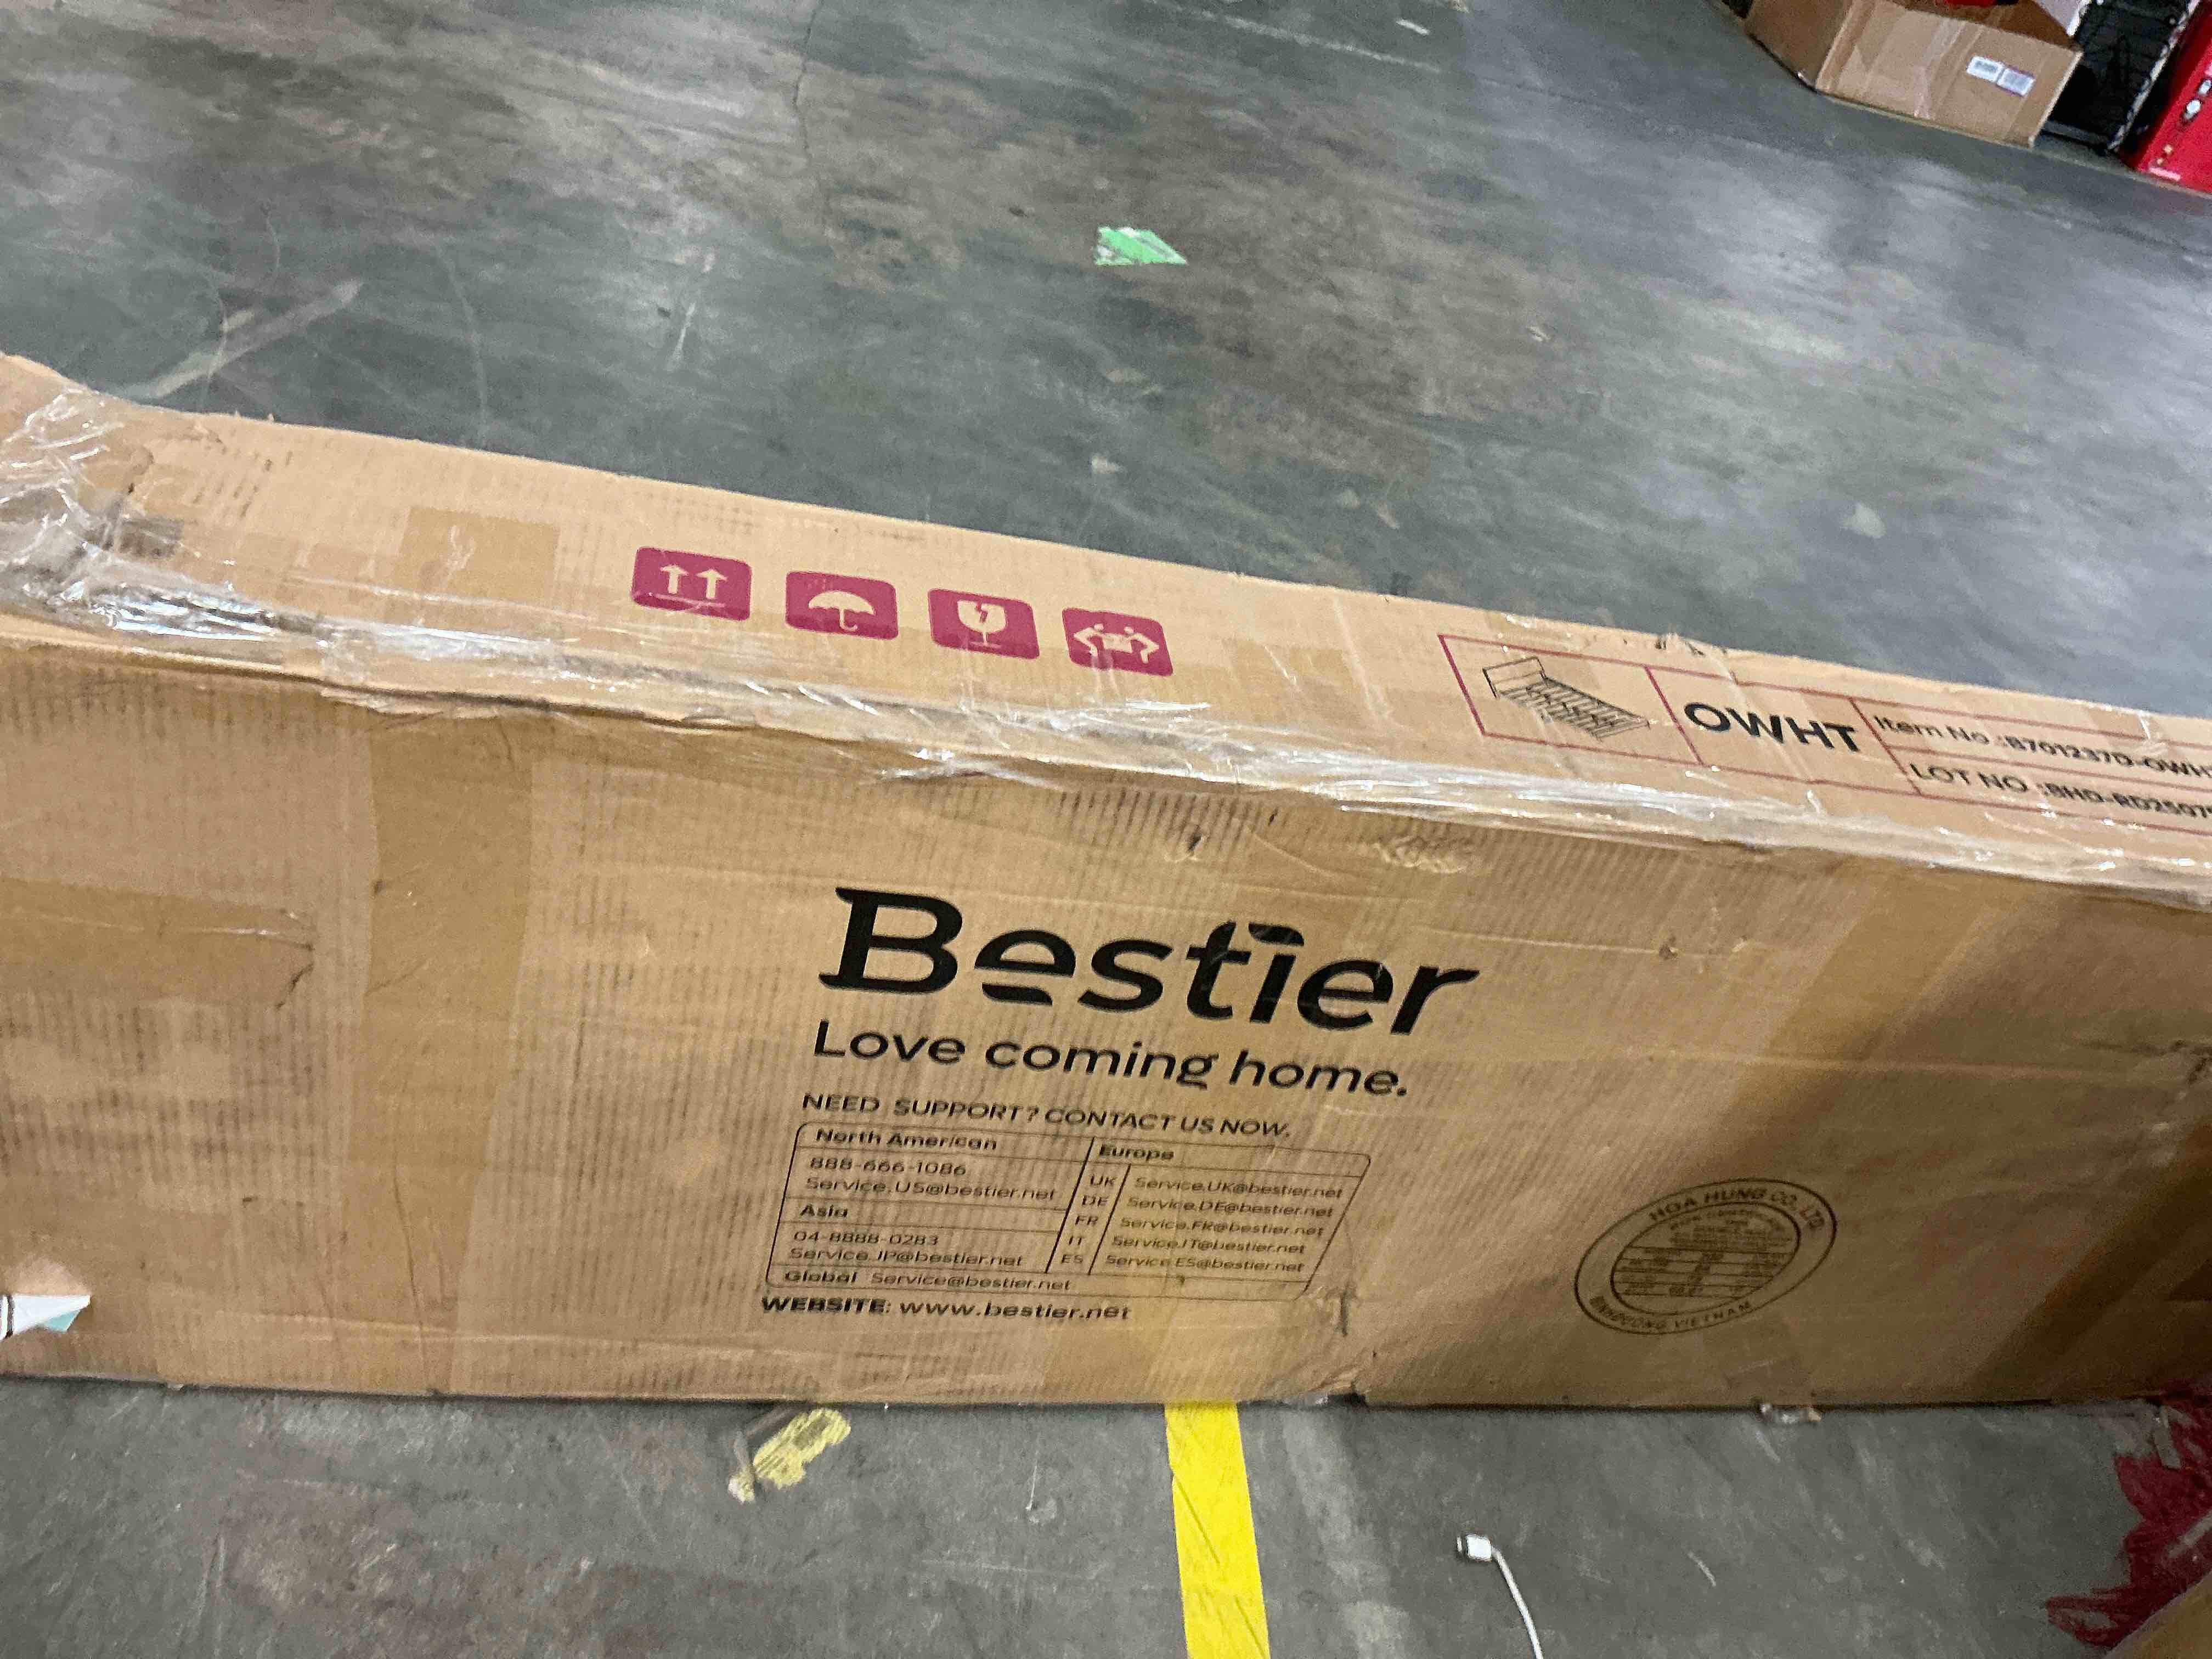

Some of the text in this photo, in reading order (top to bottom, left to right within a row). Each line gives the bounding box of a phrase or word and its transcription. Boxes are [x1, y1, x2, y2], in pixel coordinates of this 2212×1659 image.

[1683, 702, 1861, 752] OWHT
[1874, 715, 1942, 738] Item
[1910, 763, 1972, 786] LOT
[819, 886, 1480, 1036] Bestier
[814, 1019, 1408, 1097] Love coming home.
[802, 1092, 880, 1114] NEED
[1044, 1108, 1175, 1131] CONTACT
[1180, 1115, 1214, 1135] US
[815, 1127, 997, 1151] North American
[1098, 1143, 1175, 1164] Europe
[1089, 1175, 1118, 1187] UK
[799, 1203, 849, 1218] Asia
[1081, 1195, 1110, 1207] DE
[1074, 1214, 1099, 1227] FR
[1068, 1235, 1086, 1247] IT
[1060, 1254, 1085, 1265] ES
[784, 1269, 858, 1284] Global
[762, 1295, 1132, 1321] WEBSITE: www.bestier.net
